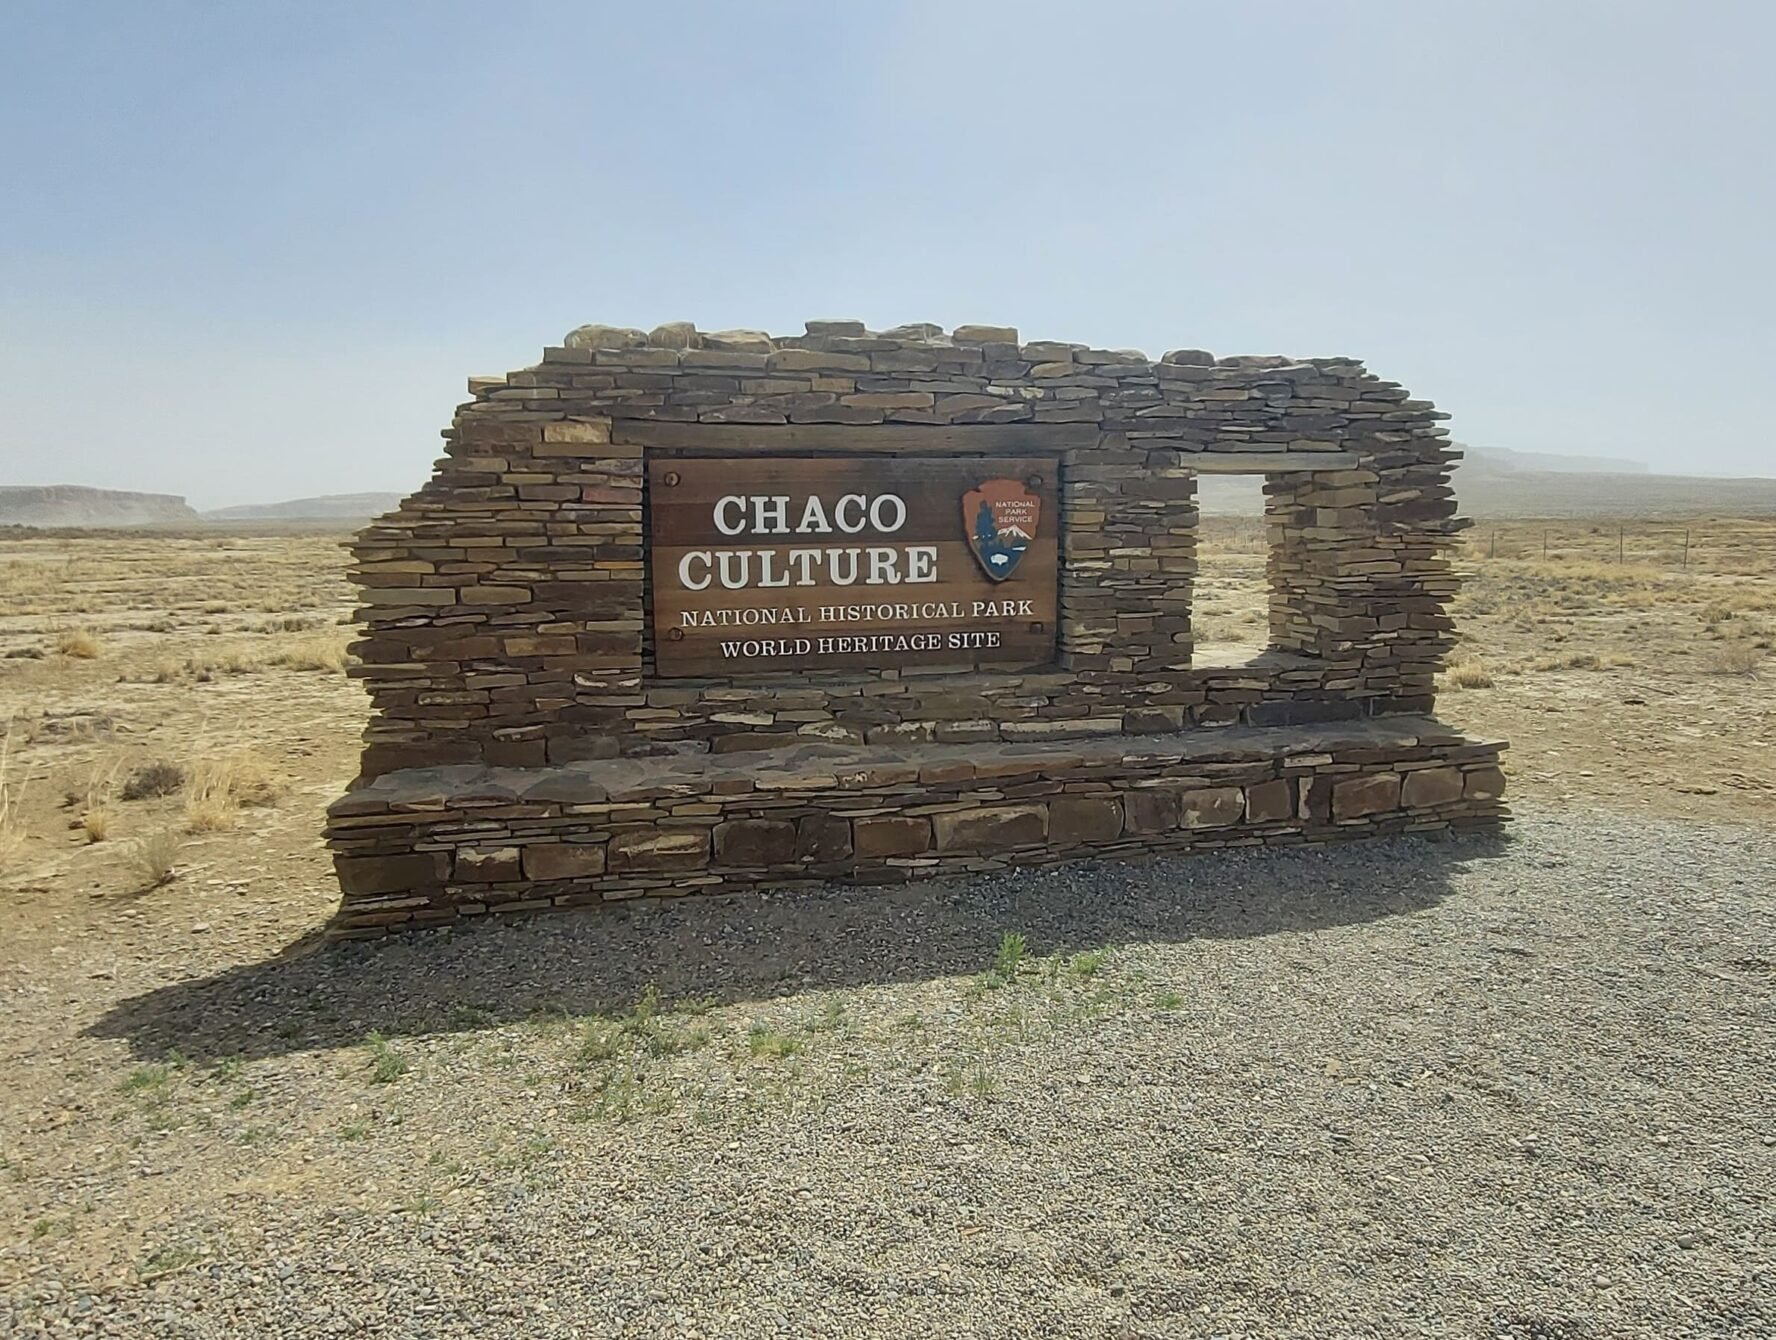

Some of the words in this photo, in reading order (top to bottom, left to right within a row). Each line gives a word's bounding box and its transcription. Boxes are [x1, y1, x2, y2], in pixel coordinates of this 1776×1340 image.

[713, 494, 907, 535] CHACO
[998, 515, 1033, 523] SERVICE
[678, 546, 938, 590] CULTURE
[680, 607, 812, 628] NATIONAL
[819, 602, 965, 623] HISTORICAL
[971, 599, 1034, 618] PARK
[720, 638, 811, 659] WORLD
[817, 633, 942, 655] HERITAGE
[948, 632, 1001, 649] SITE
